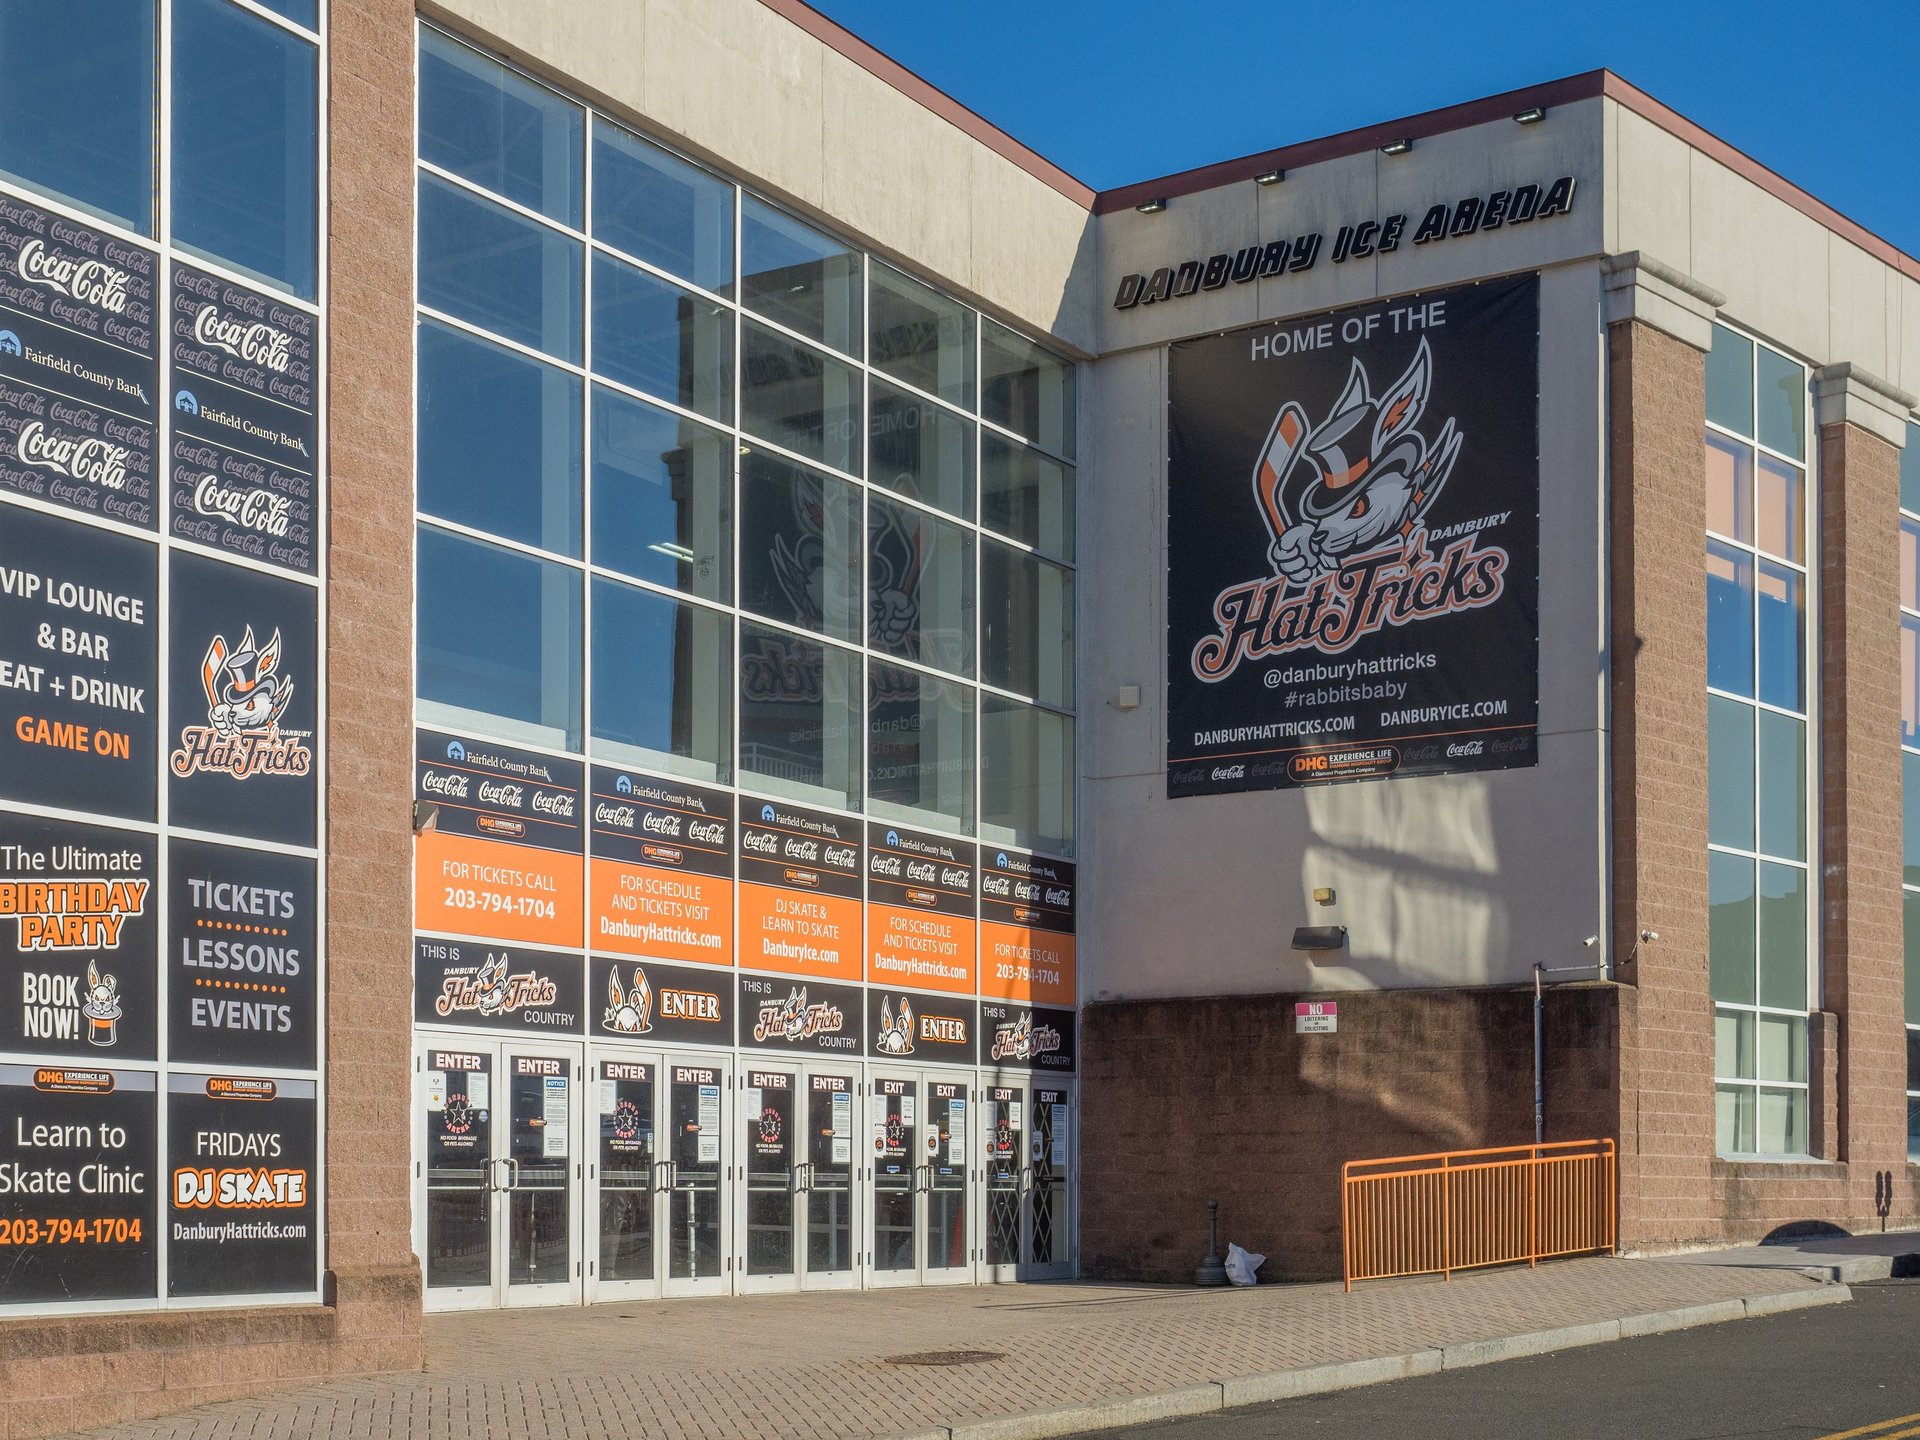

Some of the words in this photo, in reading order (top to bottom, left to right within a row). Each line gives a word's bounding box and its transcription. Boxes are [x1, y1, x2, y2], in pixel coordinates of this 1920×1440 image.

[1113, 232, 1323, 310] DANBURY
[1331, 214, 1408, 264] ICE
[1412, 175, 1578, 246] ARENA
[18, 239, 129, 314] Coca-Cola
[195, 306, 291, 372] Coca-Cola
[1251, 322, 1333, 361] HOME
[1341, 315, 1380, 343] OF
[1388, 300, 1446, 332] THE
[25, 346, 71, 374] Fairfield
[74, 364, 114, 390] County
[117, 378, 148, 401] Bank
[201, 406, 241, 431] Fairfield
[243, 420, 279, 445] County
[281, 434, 308, 454] Bank
[18, 421, 129, 490] Coca-Cola
[195, 474, 291, 538] Coca-Cola
[1429, 511, 1512, 542] DANBURY
[0, 567, 40, 598] VIP
[47, 579, 144, 625] LOUNGE
[37, 623, 56, 649] &
[62, 627, 109, 661] BAR
[1263, 652, 1437, 689] @danburyhattricks
[0, 661, 44, 692] EAT
[72, 676, 144, 713] DRINK
[1284, 680, 1407, 708] #rabbitsbaby
[1381, 700, 1507, 727] DANBURYICE.COM
[16, 716, 89, 752] GAME
[94, 730, 129, 760] ON
[280, 729, 312, 737] DANBURY
[1195, 716, 1355, 746] DANBURYHATTRICKS.COM
[1329, 751, 1374, 762] EXPERIENCE
[1378, 749, 1391, 757] LIFE
[1447, 740, 1484, 757] Coca-Cola
[467, 752, 498, 768] Fairfield
[500, 759, 528, 776] County
[530, 764, 550, 779] Bank
[1212, 765, 1245, 780] Coca-Cola
[1296, 756, 1327, 771] DHG
[423, 770, 469, 798] Coca-Cola
[479, 780, 523, 807] Coca-Cola
[532, 791, 574, 817] Coca-Cola
[633, 785, 660, 799] Fairfield
[662, 791, 685, 807] County
[687, 796, 704, 810] Bank
[596, 802, 635, 828] Coca-Cola
[643, 812, 680, 836] Coca-Cola
[689, 820, 725, 844] Coca-Cola
[776, 814, 799, 827] Fairfield
[801, 819, 821, 833] County
[823, 824, 838, 836] Bank
[2, 846, 45, 871] The
[52, 846, 141, 871] Ultimate
[744, 830, 778, 853] Coca-Cola
[785, 839, 818, 860] Coca-Cola
[825, 846, 856, 867] Coca-Cola
[443, 861, 469, 879] FOR
[472, 865, 522, 887] TICKETS
[526, 873, 556, 892] CALL
[621, 875, 642, 892] FOR
[646, 879, 701, 900] SCHEDULE
[0, 879, 148, 916] BIRTHDAY
[188, 879, 295, 918] TICKETS
[444, 887, 555, 919] 203-794-1704
[612, 894, 637, 911] AND
[640, 898, 682, 917] TICKETS
[685, 904, 710, 920] VISIT
[776, 899, 787, 913] DJ
[790, 901, 817, 918] SKATE
[820, 906, 826, 919] &
[19, 915, 123, 950] PARTY
[601, 916, 721, 948] DanburyHattricks.com
[763, 915, 794, 933] LEARN
[796, 921, 809, 935] TO
[812, 923, 839, 939] SKATE
[891, 917, 908, 931] FOR
[909, 921, 951, 937] SCHEDULE
[421, 944, 446, 959] THIS
[450, 948, 460, 961] IS
[763, 938, 839, 963] DanburyIce.com
[884, 933, 902, 948] AND
[904, 936, 937, 953] TICKETS
[939, 941, 958, 955] VISIT
[995, 944, 1010, 956] FOR
[1012, 946, 1040, 960] TICKETS
[1042, 950, 1060, 964] CALL
[183, 938, 300, 976] LESSONS
[875, 953, 967, 980] DanburyHattricks.com
[444, 967, 479, 975] DANBURY
[996, 964, 1059, 984] 203-794-1704
[23, 972, 79, 1007] BOOK
[743, 980, 761, 993] THIS
[764, 983, 771, 994] IS
[191, 998, 292, 1032] EVENTS
[662, 990, 720, 1019] ENTER
[760, 999, 786, 1007] DANBURY
[983, 1007, 998, 1018] THIS
[999, 1008, 1005, 1018] IS
[1309, 1004, 1323, 1014] NO
[23, 1007, 79, 1040] NOW!
[524, 1010, 574, 1026] COUNTRY
[921, 1017, 965, 1042] ENTER
[819, 1036, 856, 1048] COUNTRY
[436, 1053, 481, 1070] ENTER
[518, 1059, 560, 1074] ENTER
[607, 1064, 645, 1079] ENTER
[1042, 1055, 1070, 1066] COUNTRY
[38, 1072, 63, 1084] DHG
[64, 1072, 97, 1080] EXPERIENCE
[210, 1080, 232, 1091] DHG
[677, 1069, 712, 1083] ENTER
[753, 1074, 787, 1088] ENTER
[814, 1077, 845, 1090] ENTER
[884, 1081, 904, 1093] EXIT
[937, 1085, 956, 1097] EXIT
[995, 1089, 1012, 1100] EXIT
[1041, 1092, 1058, 1102] EXIT
[17, 1117, 95, 1148] Learn
[99, 1123, 126, 1148] to
[197, 1132, 281, 1158] FRIDAYS
[0, 1164, 71, 1194] Skate
[79, 1164, 144, 1193] Clinic
[175, 1168, 217, 1207] DJ
[218, 1168, 305, 1208] SKATE
[0, 1218, 141, 1245] 203-794-1704
[173, 1222, 306, 1242] DanburyHattricks.com
